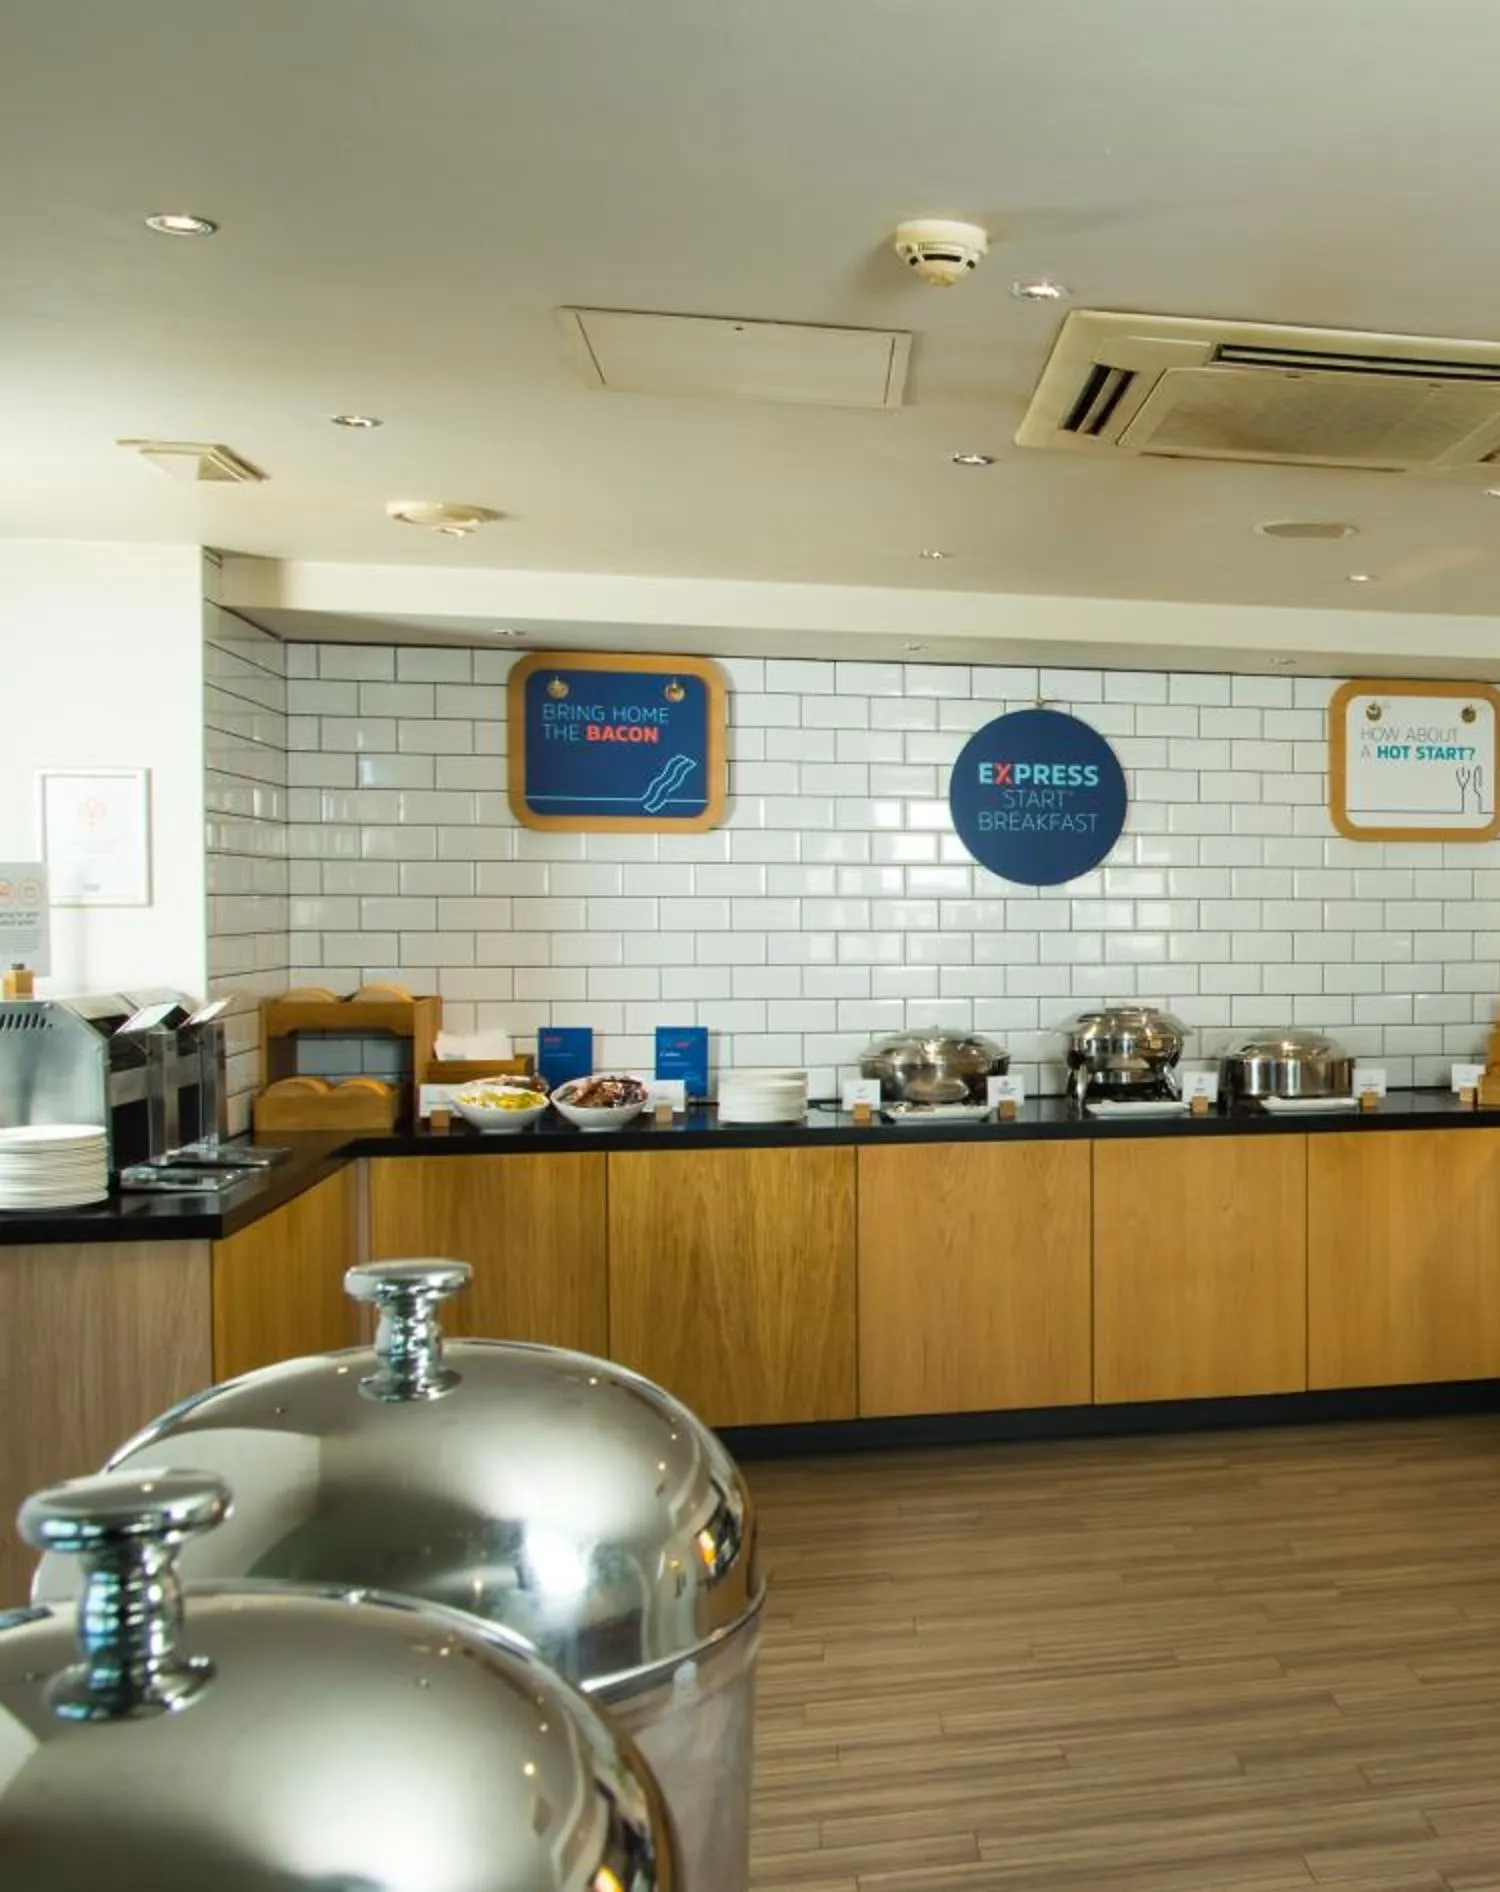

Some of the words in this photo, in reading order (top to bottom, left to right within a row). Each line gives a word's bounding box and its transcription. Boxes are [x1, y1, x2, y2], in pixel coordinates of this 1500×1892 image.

[543, 704, 605, 722] BRING
[613, 706, 669, 724] HOME
[544, 723, 580, 741] THE
[586, 724, 659, 743] BACON
[1361, 727, 1399, 741] HOW
[1405, 727, 1459, 742] ABOUT
[1361, 744, 1370, 758] A
[1377, 745, 1411, 760] HOT
[1415, 746, 1476, 761] START?
[978, 762, 1099, 786] EXPRESS
[977, 811, 1098, 833] BREAKFAST
